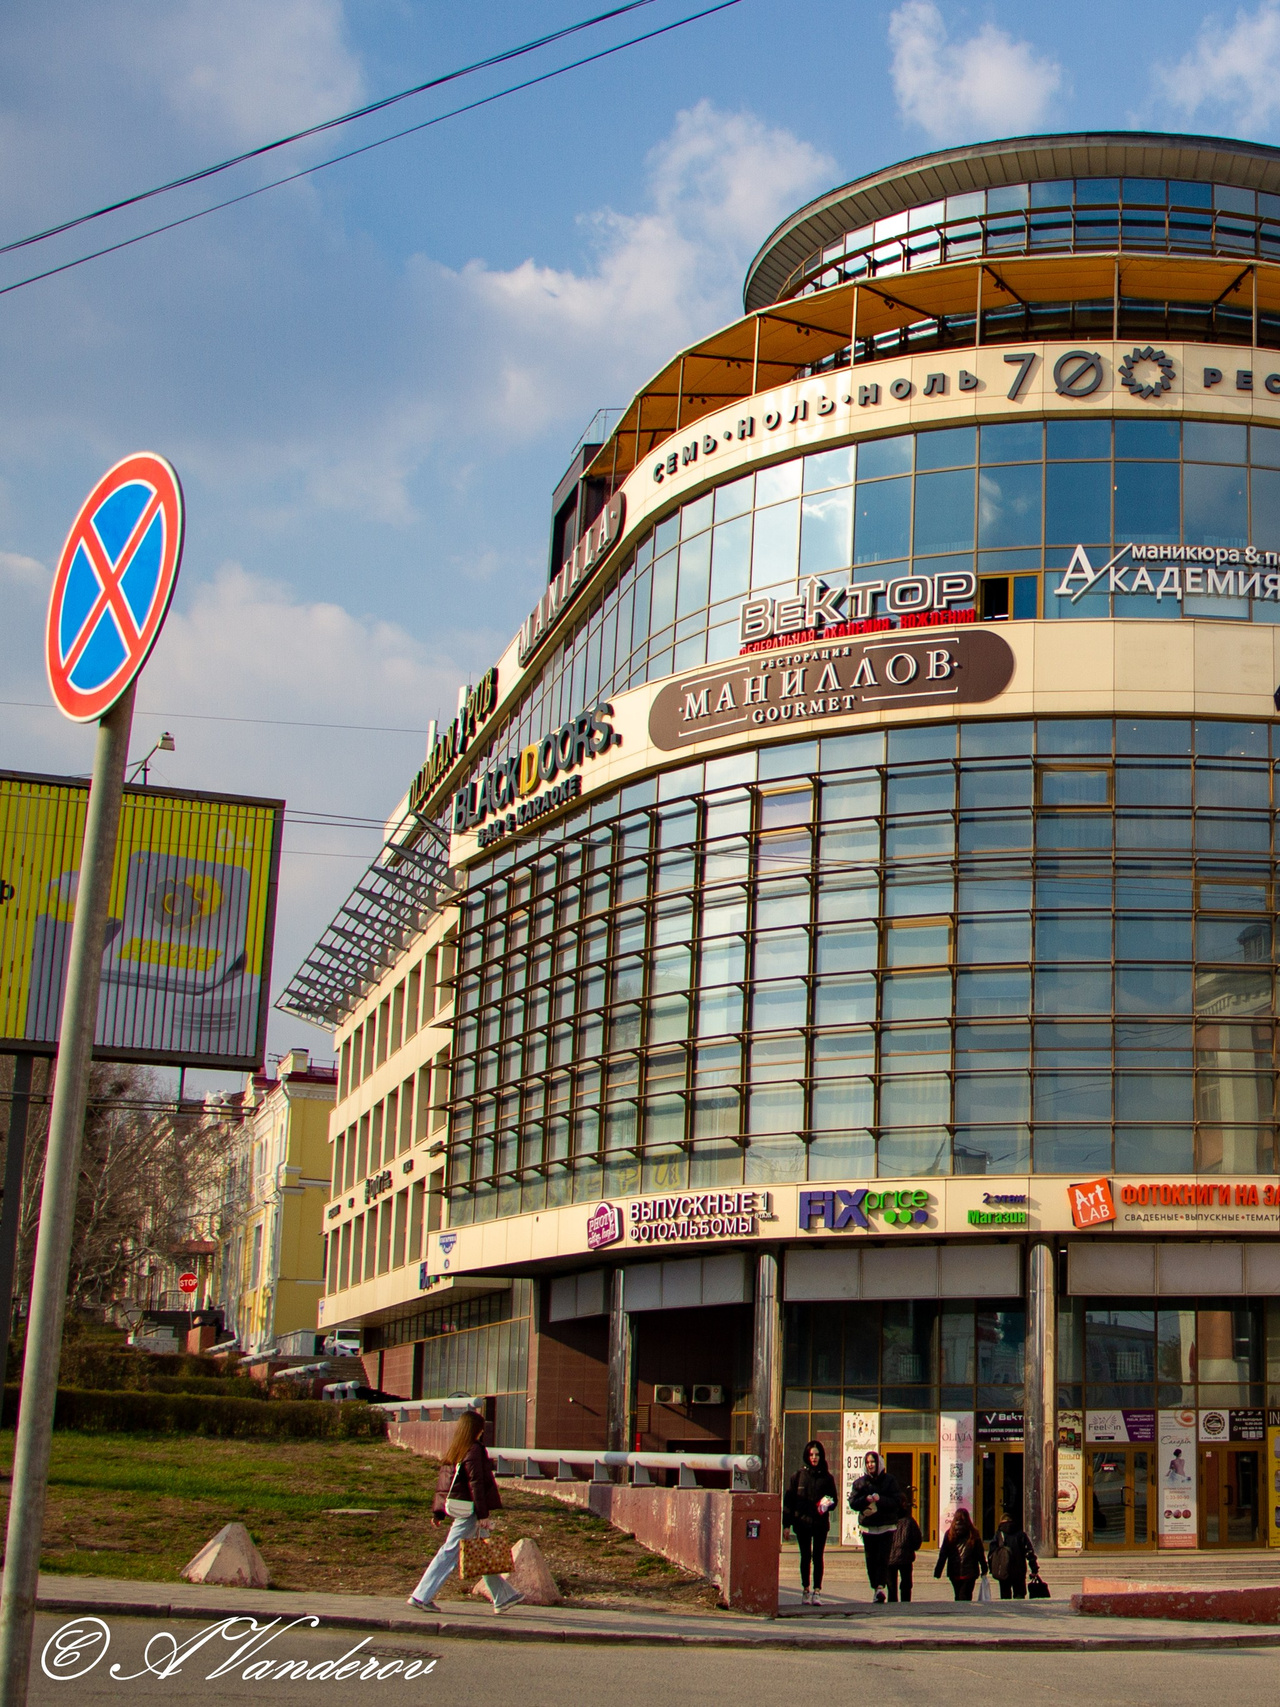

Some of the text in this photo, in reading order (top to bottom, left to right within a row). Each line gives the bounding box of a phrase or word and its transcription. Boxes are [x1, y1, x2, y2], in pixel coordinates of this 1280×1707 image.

[1132, 545, 1240, 566] маникюра
[1244, 546, 1261, 564] &
[519, 511, 612, 661] MANILLA
[823, 617, 892, 639] АКАДЕМИЯ
[899, 608, 976, 630] ВОЖДЕНИЯ
[760, 646, 852, 671] РЕСТОРАЦИЯ
[751, 694, 858, 724] GOURMET
[516, 775, 583, 826] KARAOKE
[629, 1192, 755, 1222] ВЫПУСКНЫЕ
[982, 1192, 991, 1204] 2
[1075, 1184, 1106, 1211] Art
[1120, 1184, 1231, 1207] ФОТОКНИГИ
[1235, 1184, 1259, 1207] НА
[967, 1210, 1027, 1225] Магазин
[1079, 1204, 1110, 1223] LAB
[629, 1217, 755, 1241] ФОТОАЛЬБОМЫ
[179, 1278, 198, 1287] STOP
